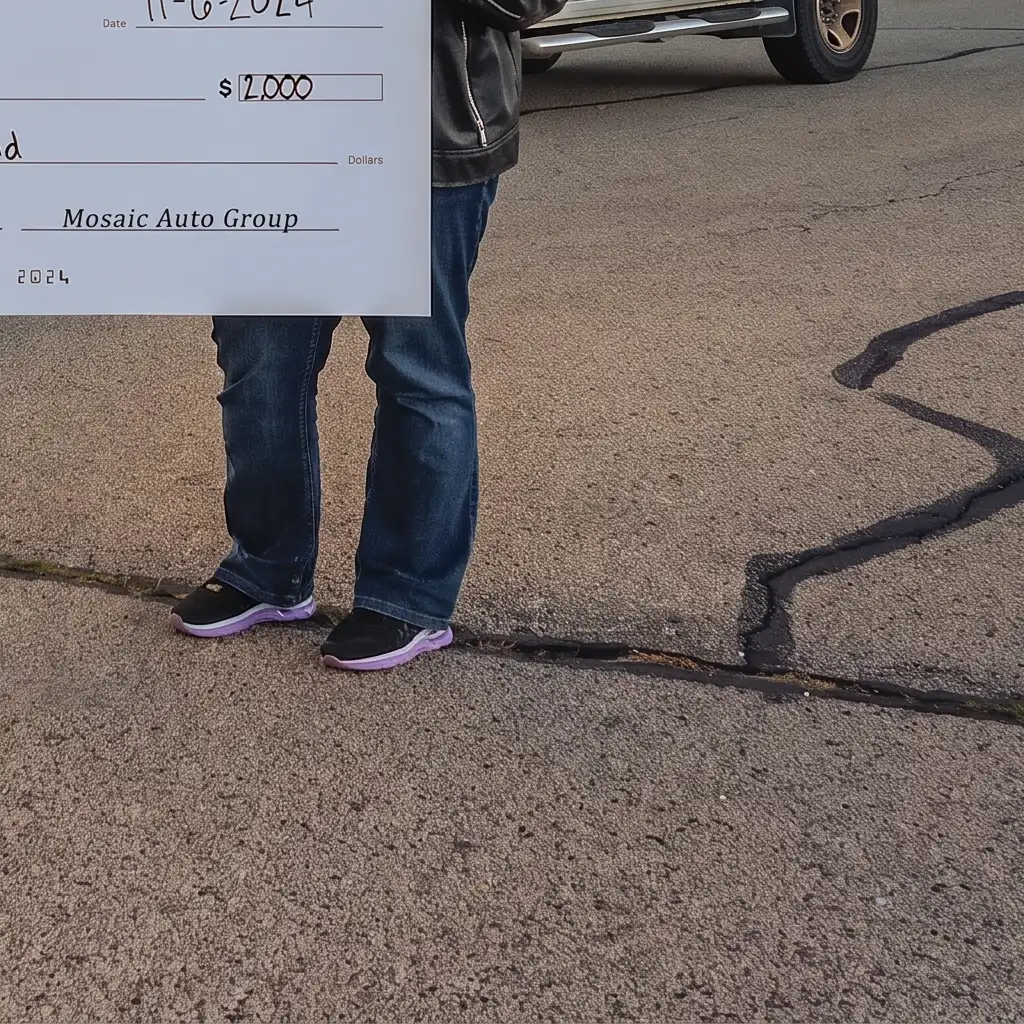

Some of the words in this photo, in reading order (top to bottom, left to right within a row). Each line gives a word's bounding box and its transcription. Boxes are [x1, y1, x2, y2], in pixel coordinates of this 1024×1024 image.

[102, 18, 127, 29] Date
[218, 77, 232, 99] $
[244, 74, 313, 101] 2,000
[348, 154, 384, 165] Dollars
[63, 209, 148, 228] Mosaic
[156, 209, 214, 228] Auto
[223, 208, 298, 233] Group
[17, 269, 70, 285] 2024
